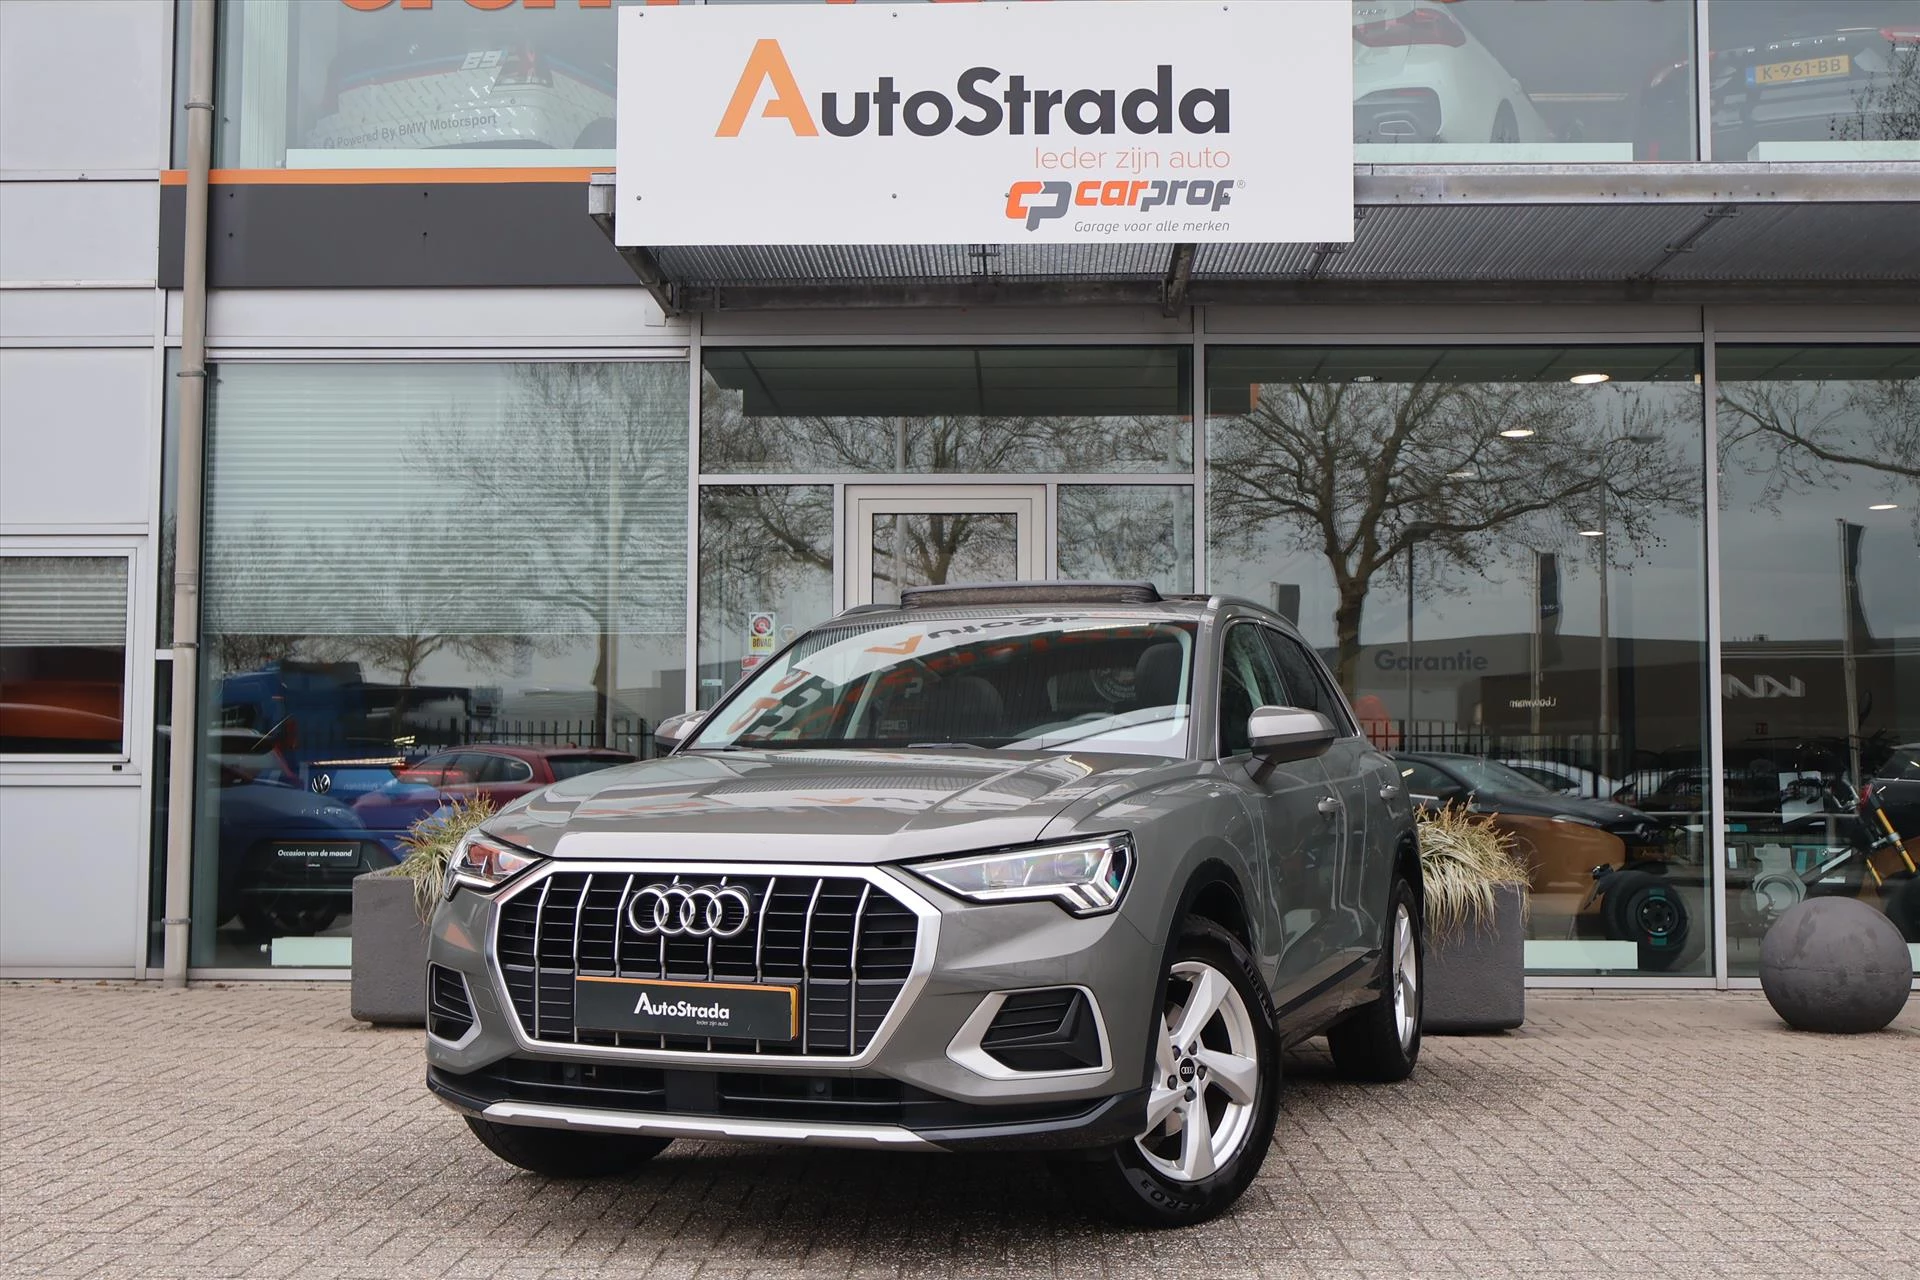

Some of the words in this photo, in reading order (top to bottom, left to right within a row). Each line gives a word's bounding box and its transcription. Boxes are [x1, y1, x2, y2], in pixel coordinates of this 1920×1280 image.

[460, 50, 502, 71] 69
[1762, 58, 1842, 81] K-961-BB
[715, 38, 1230, 137] AutoStrada
[336, 125, 379, 147] Powered
[381, 126, 397, 141] By
[399, 121, 428, 137] BMW
[430, 114, 498, 132] Motorsport
[1035, 146, 1107, 169] Ieder
[1116, 147, 1159, 174] zijn
[1169, 149, 1231, 169] auto
[1074, 221, 1120, 235] Garage
[1124, 222, 1154, 232] voor
[1155, 220, 1178, 232] alle
[1180, 220, 1230, 232] merken
[752, 637, 772, 648] BOVAG
[1374, 648, 1489, 672] Garantie
[277, 848, 306, 858] Occasion
[306, 850, 319, 858] van
[320, 848, 328, 857] de
[329, 848, 353, 858] maand
[633, 992, 730, 1019] AutoStrada
